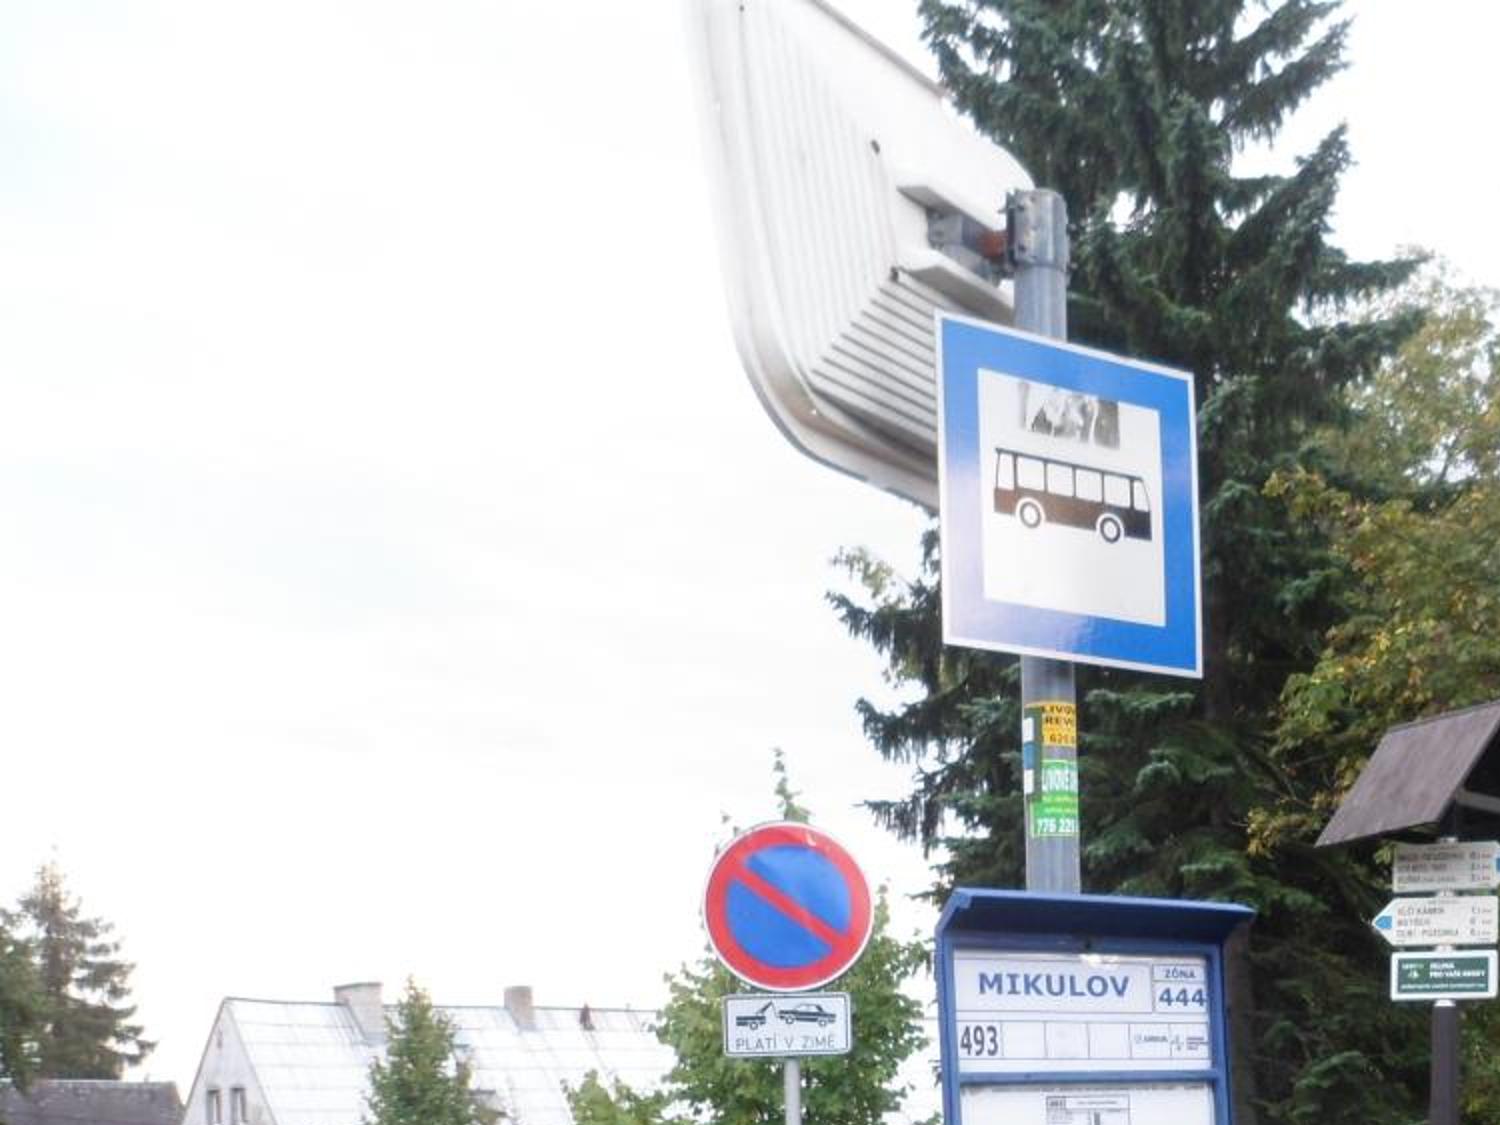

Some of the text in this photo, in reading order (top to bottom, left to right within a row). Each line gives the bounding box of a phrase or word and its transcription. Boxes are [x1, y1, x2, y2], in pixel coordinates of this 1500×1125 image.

[979, 972, 1129, 998] MIKULOV
[1159, 987, 1207, 1007] 444
[735, 1033, 777, 1051] PLATÍ
[784, 1037, 794, 1049] V
[960, 1025, 999, 1057] 493
